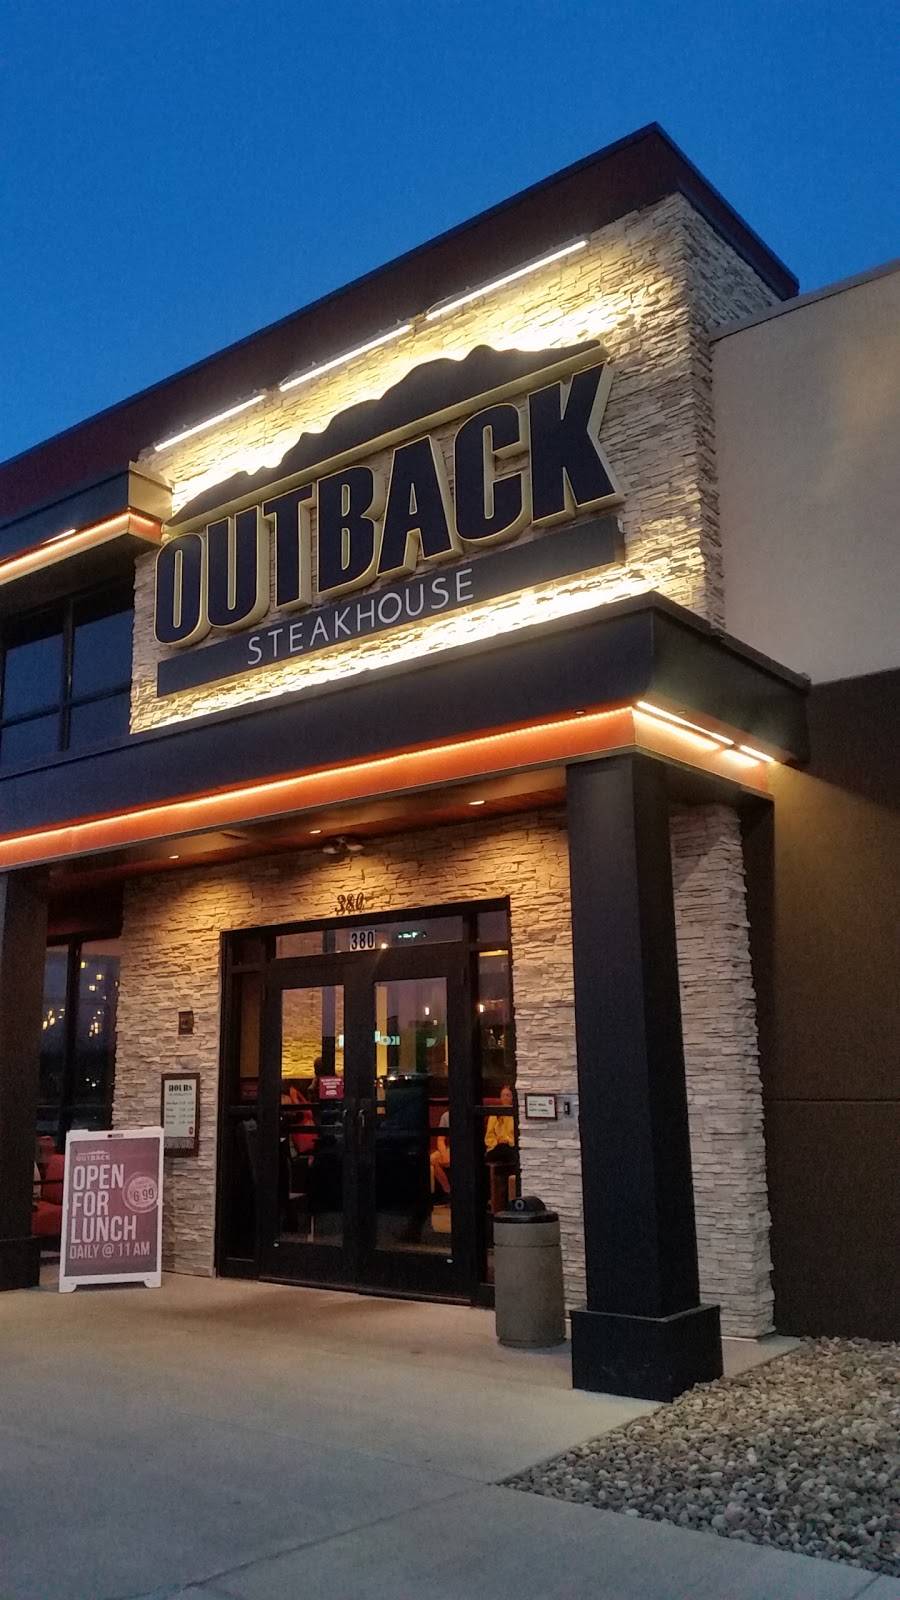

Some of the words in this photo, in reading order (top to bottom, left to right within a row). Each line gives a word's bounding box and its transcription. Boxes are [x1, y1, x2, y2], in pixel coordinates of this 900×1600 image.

[154, 362, 622, 646] OUTBACK
[247, 569, 474, 665] STEAKHOUSE
[335, 892, 364, 915] 380
[351, 931, 374, 950] 380
[168, 1084, 193, 1092] HOURS
[76, 1153, 111, 1162] OUTBACK
[73, 1164, 125, 1190] OPEN
[72, 1190, 109, 1217] FOR
[71, 1215, 137, 1244] LUNCH
[69, 1244, 100, 1260] DAILY
[102, 1243, 115, 1258] @
[118, 1242, 130, 1257] 11
[133, 1241, 150, 1256] AM
